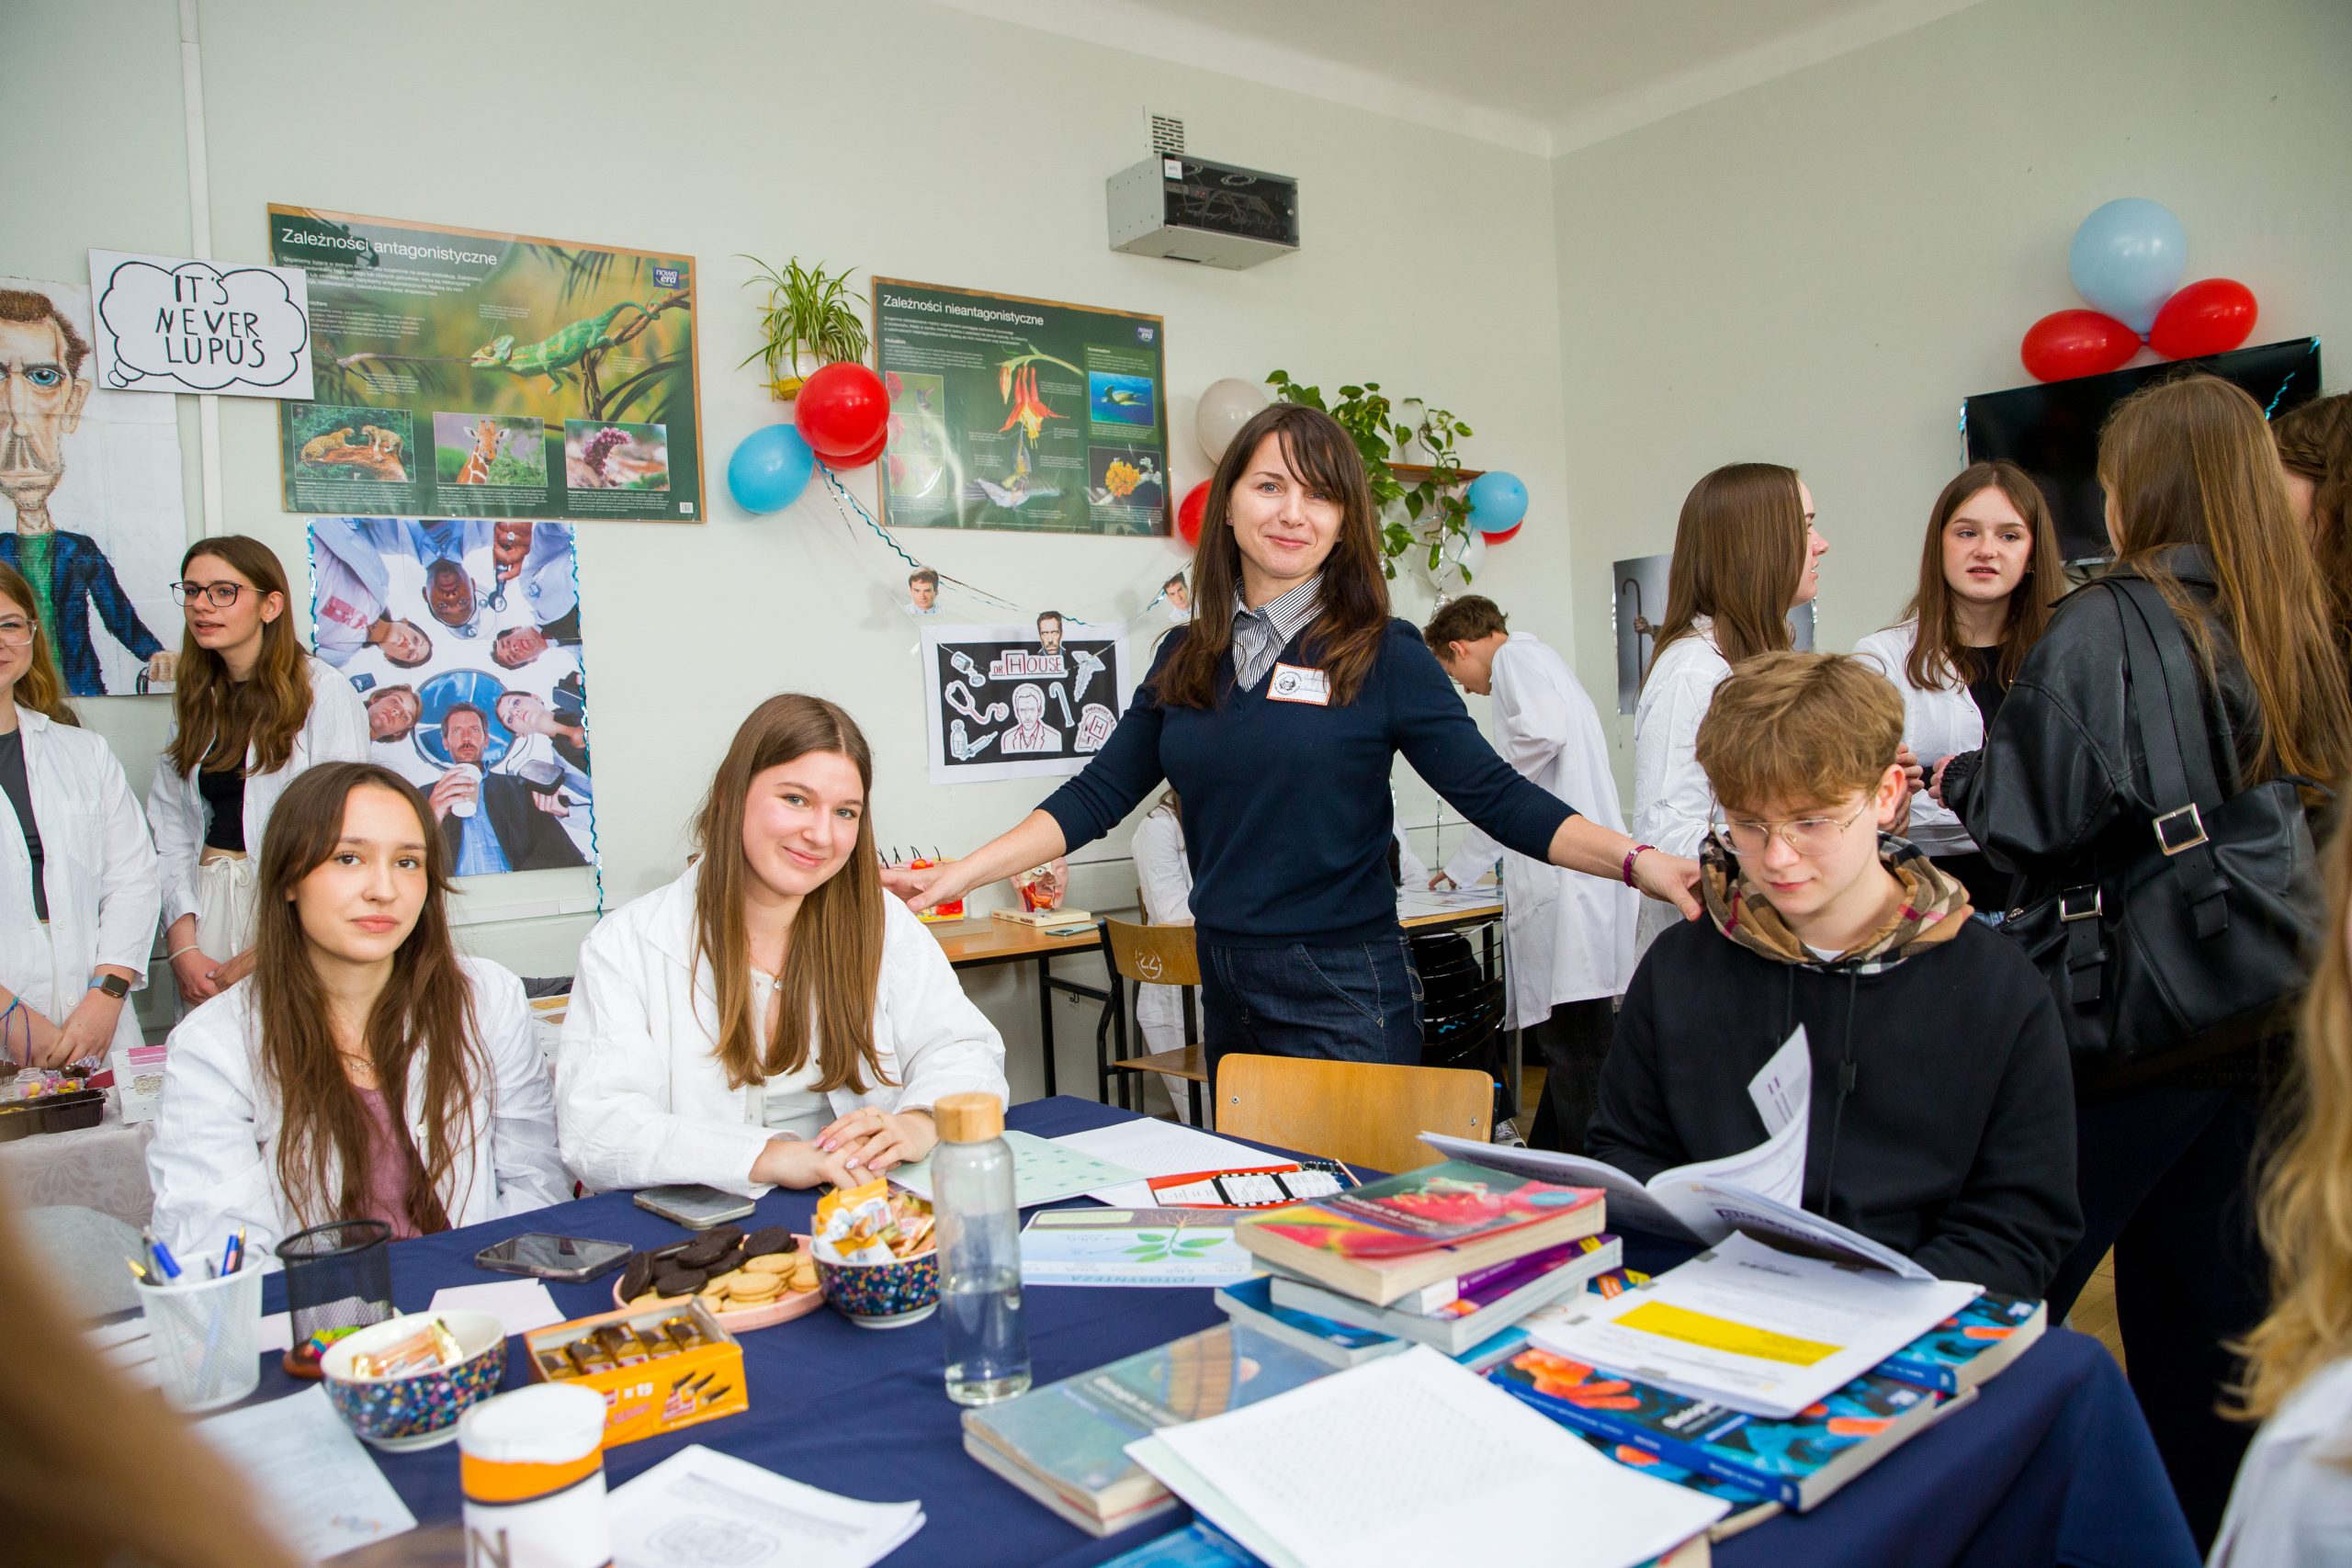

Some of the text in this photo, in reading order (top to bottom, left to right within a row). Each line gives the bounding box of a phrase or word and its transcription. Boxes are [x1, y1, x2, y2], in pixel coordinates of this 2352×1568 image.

[282, 228, 497, 265] Zależności antagonistyczne
[656, 268, 677, 277] nowa
[175, 275, 229, 305] IT'S
[155, 308, 259, 338] NEVER
[883, 295, 943, 313] Zależności
[945, 303, 1044, 326] nieantagonistyczne
[165, 336, 266, 368] LUPUS
[993, 656, 1062, 674] DR HOUSE
[1138, 952, 1159, 971] 22
[1071, 1275, 1195, 1283] FOTOSYNTEZA
